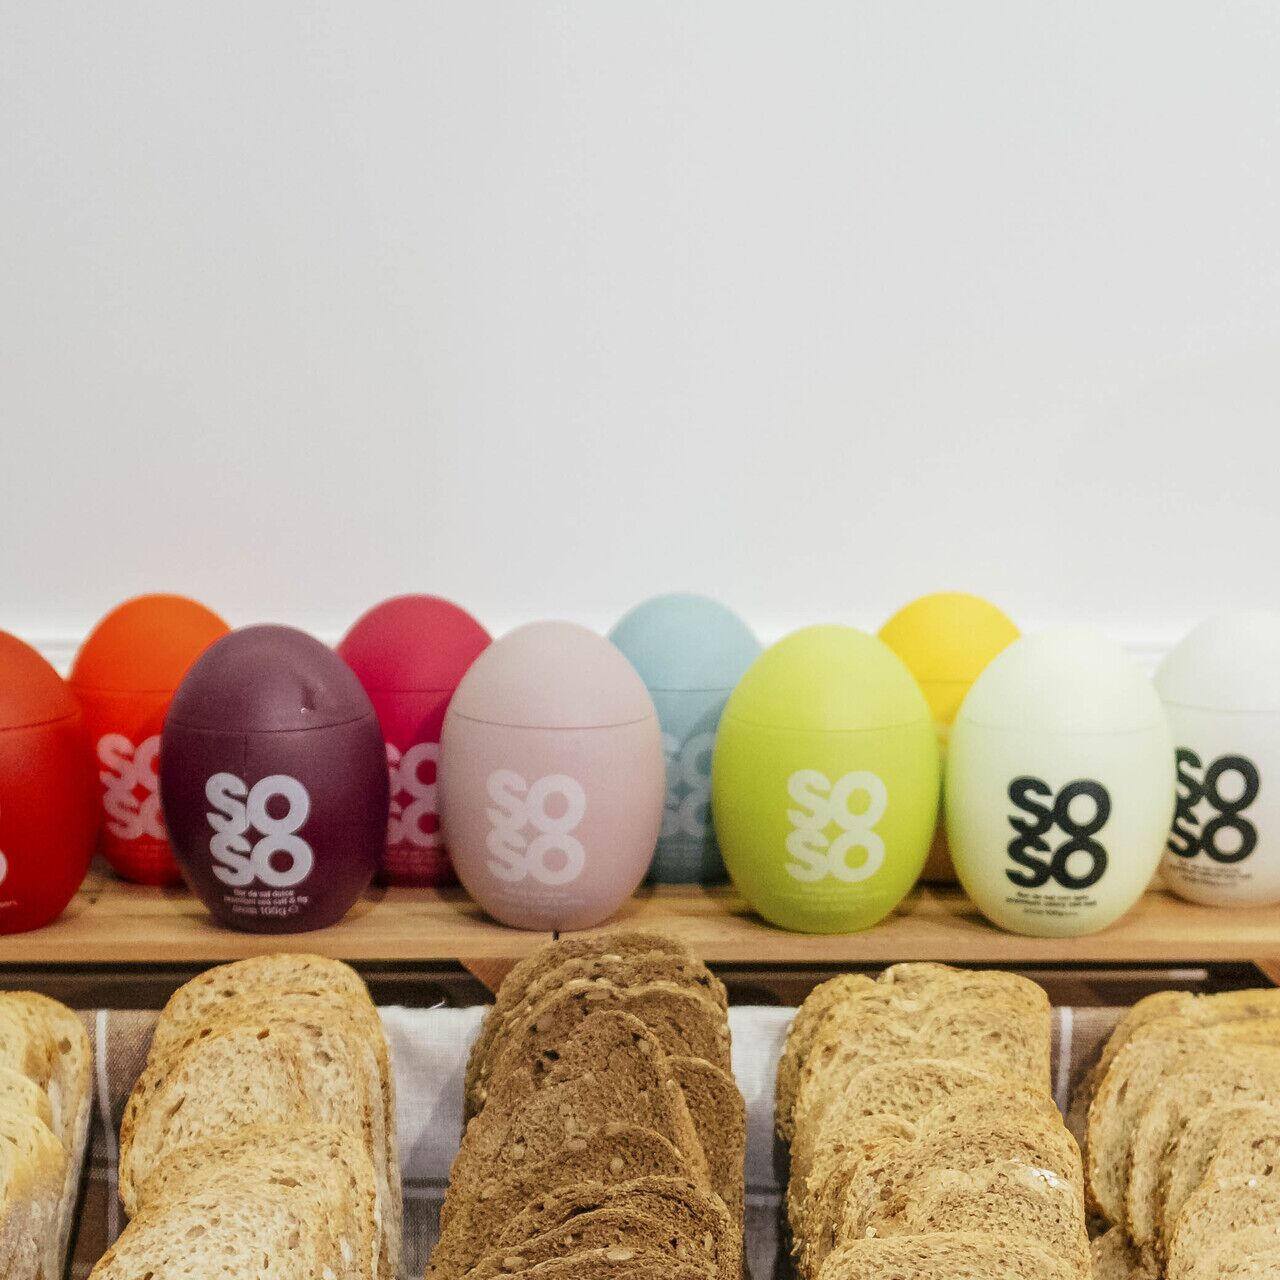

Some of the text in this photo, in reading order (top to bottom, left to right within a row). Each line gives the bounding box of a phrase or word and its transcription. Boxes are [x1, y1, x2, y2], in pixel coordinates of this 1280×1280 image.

[205, 772, 310, 835] SO
[486, 769, 587, 833] SO
[787, 769, 888, 832] SO
[1007, 776, 1112, 837] SO
[210, 830, 314, 888] SO
[485, 829, 586, 885] SO
[784, 827, 885, 882] SO
[1005, 832, 1109, 889] SO
